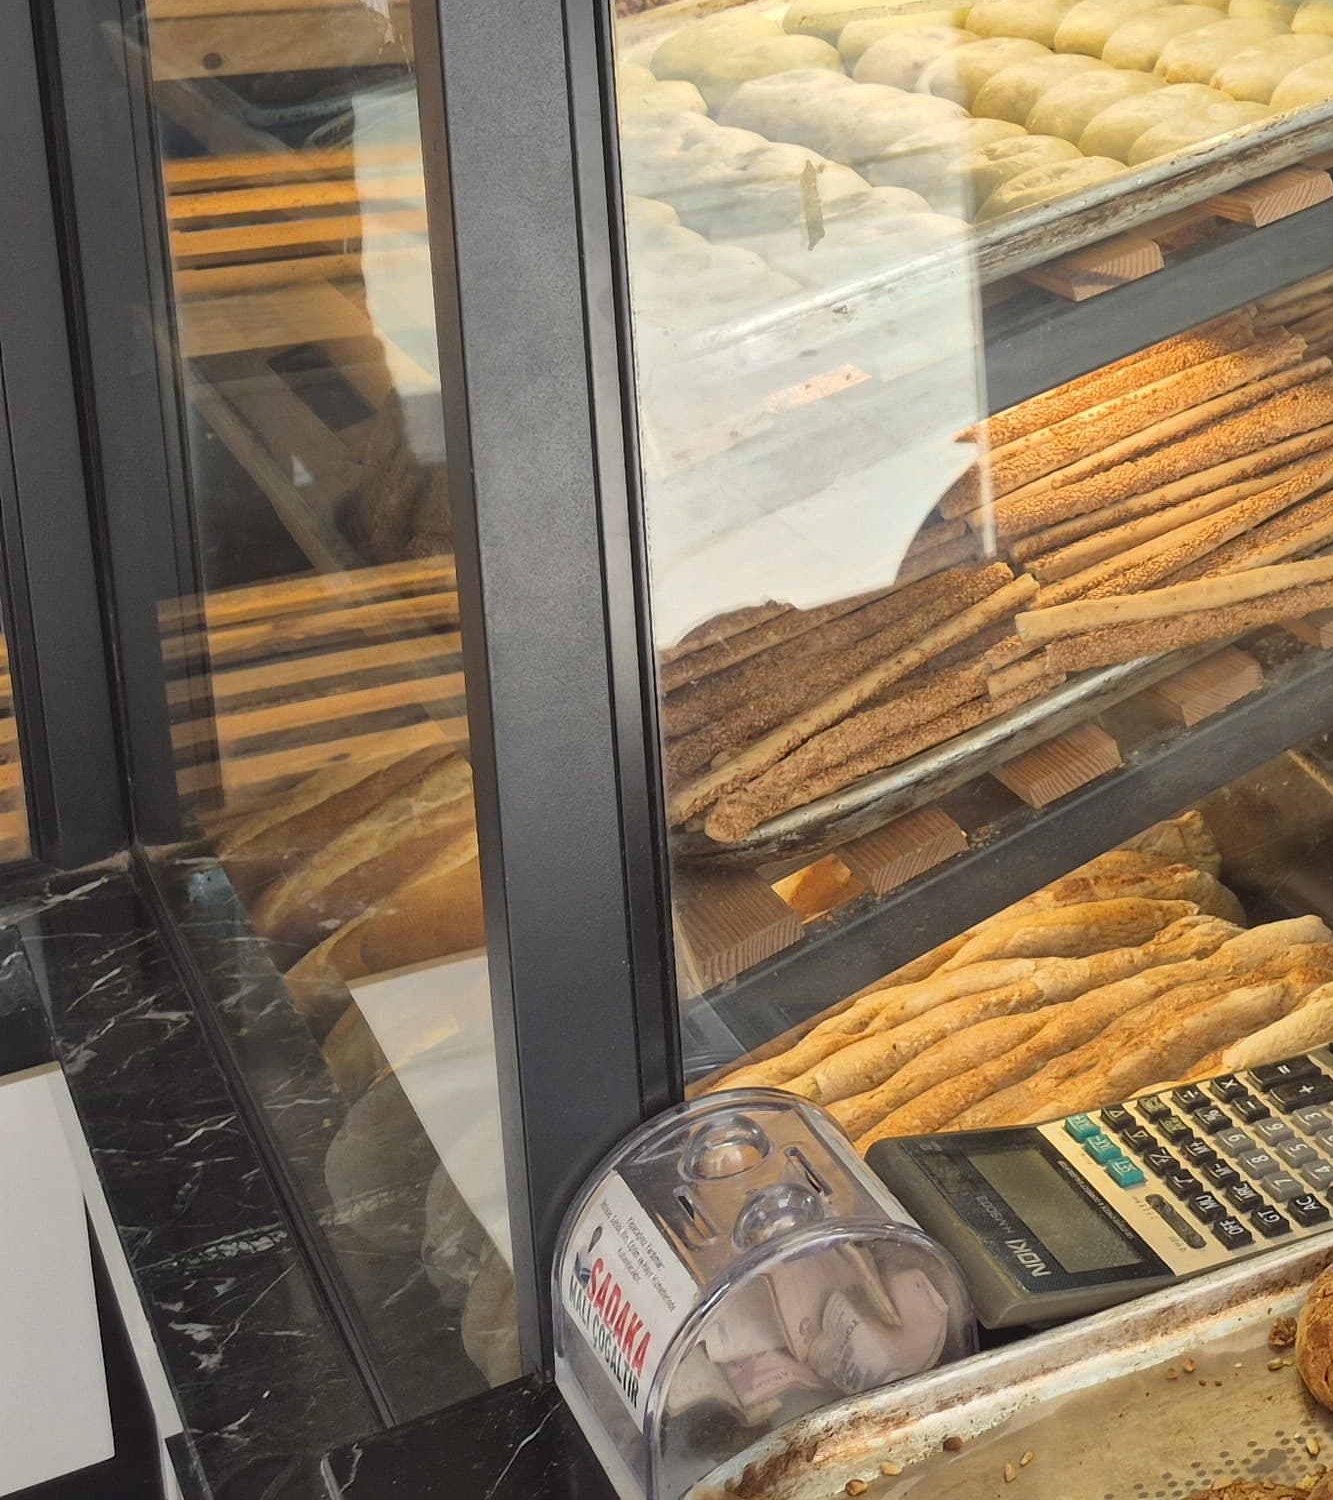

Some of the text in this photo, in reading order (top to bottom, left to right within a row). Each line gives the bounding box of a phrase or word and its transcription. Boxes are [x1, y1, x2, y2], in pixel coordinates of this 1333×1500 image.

[1304, 1112, 1322, 1120] 3
[1266, 1123, 1284, 1131] 6
[1228, 1133, 1247, 1142] 9
[1289, 1143, 1308, 1152] 5
[1251, 1154, 1269, 1164] 8
[1314, 1165, 1331, 1173] 4
[1232, 1183, 1258, 1199] MRC
[1195, 1195, 1218, 1209] MU
[1295, 1195, 1321, 1211] AC
[1257, 1210, 1280, 1223] GT
[1220, 1220, 1244, 1235] OFF
[1005, 1238, 1052, 1277] NOKI
[569, 1274, 591, 1331] MALI
[587, 1258, 651, 1378] SADAKA
